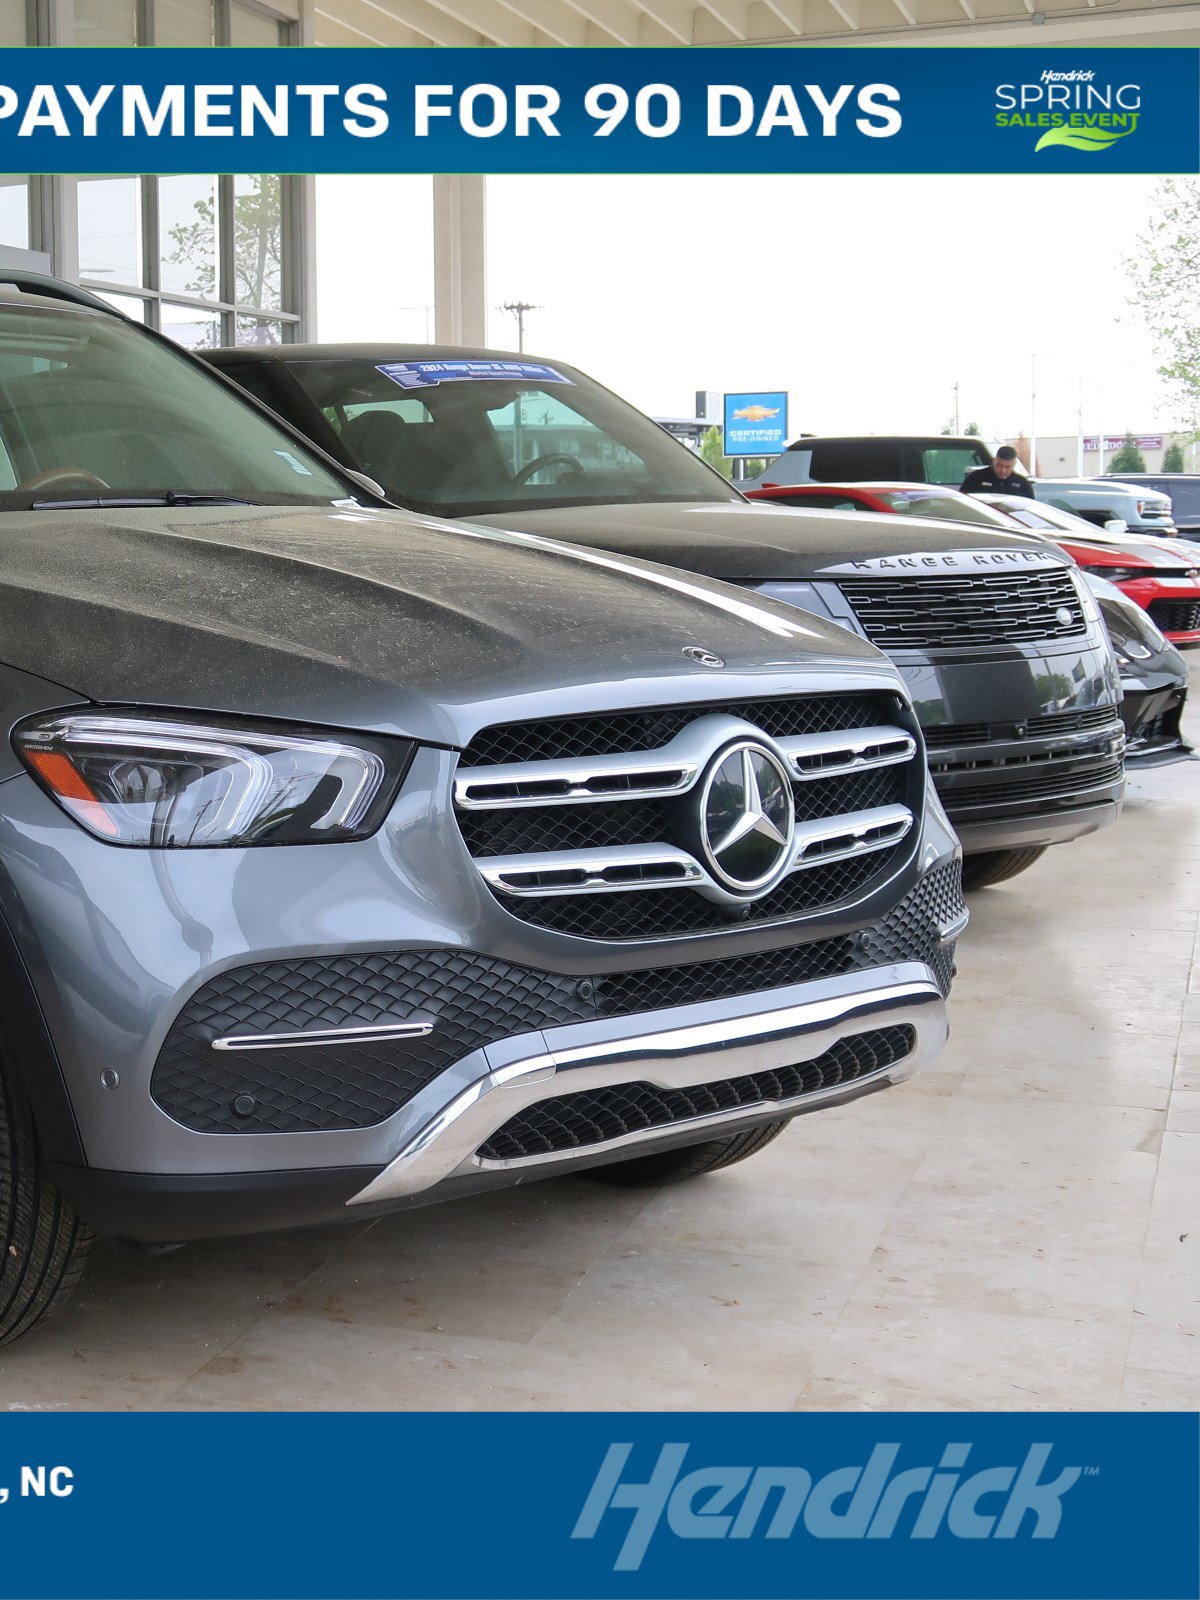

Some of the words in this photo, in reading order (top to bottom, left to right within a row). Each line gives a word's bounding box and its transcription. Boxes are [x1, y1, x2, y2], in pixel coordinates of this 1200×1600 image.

[730, 429, 782, 437] CERTIFIED
[850, 557, 960, 570] RANGE
[972, 551, 1050, 566] ROVER
